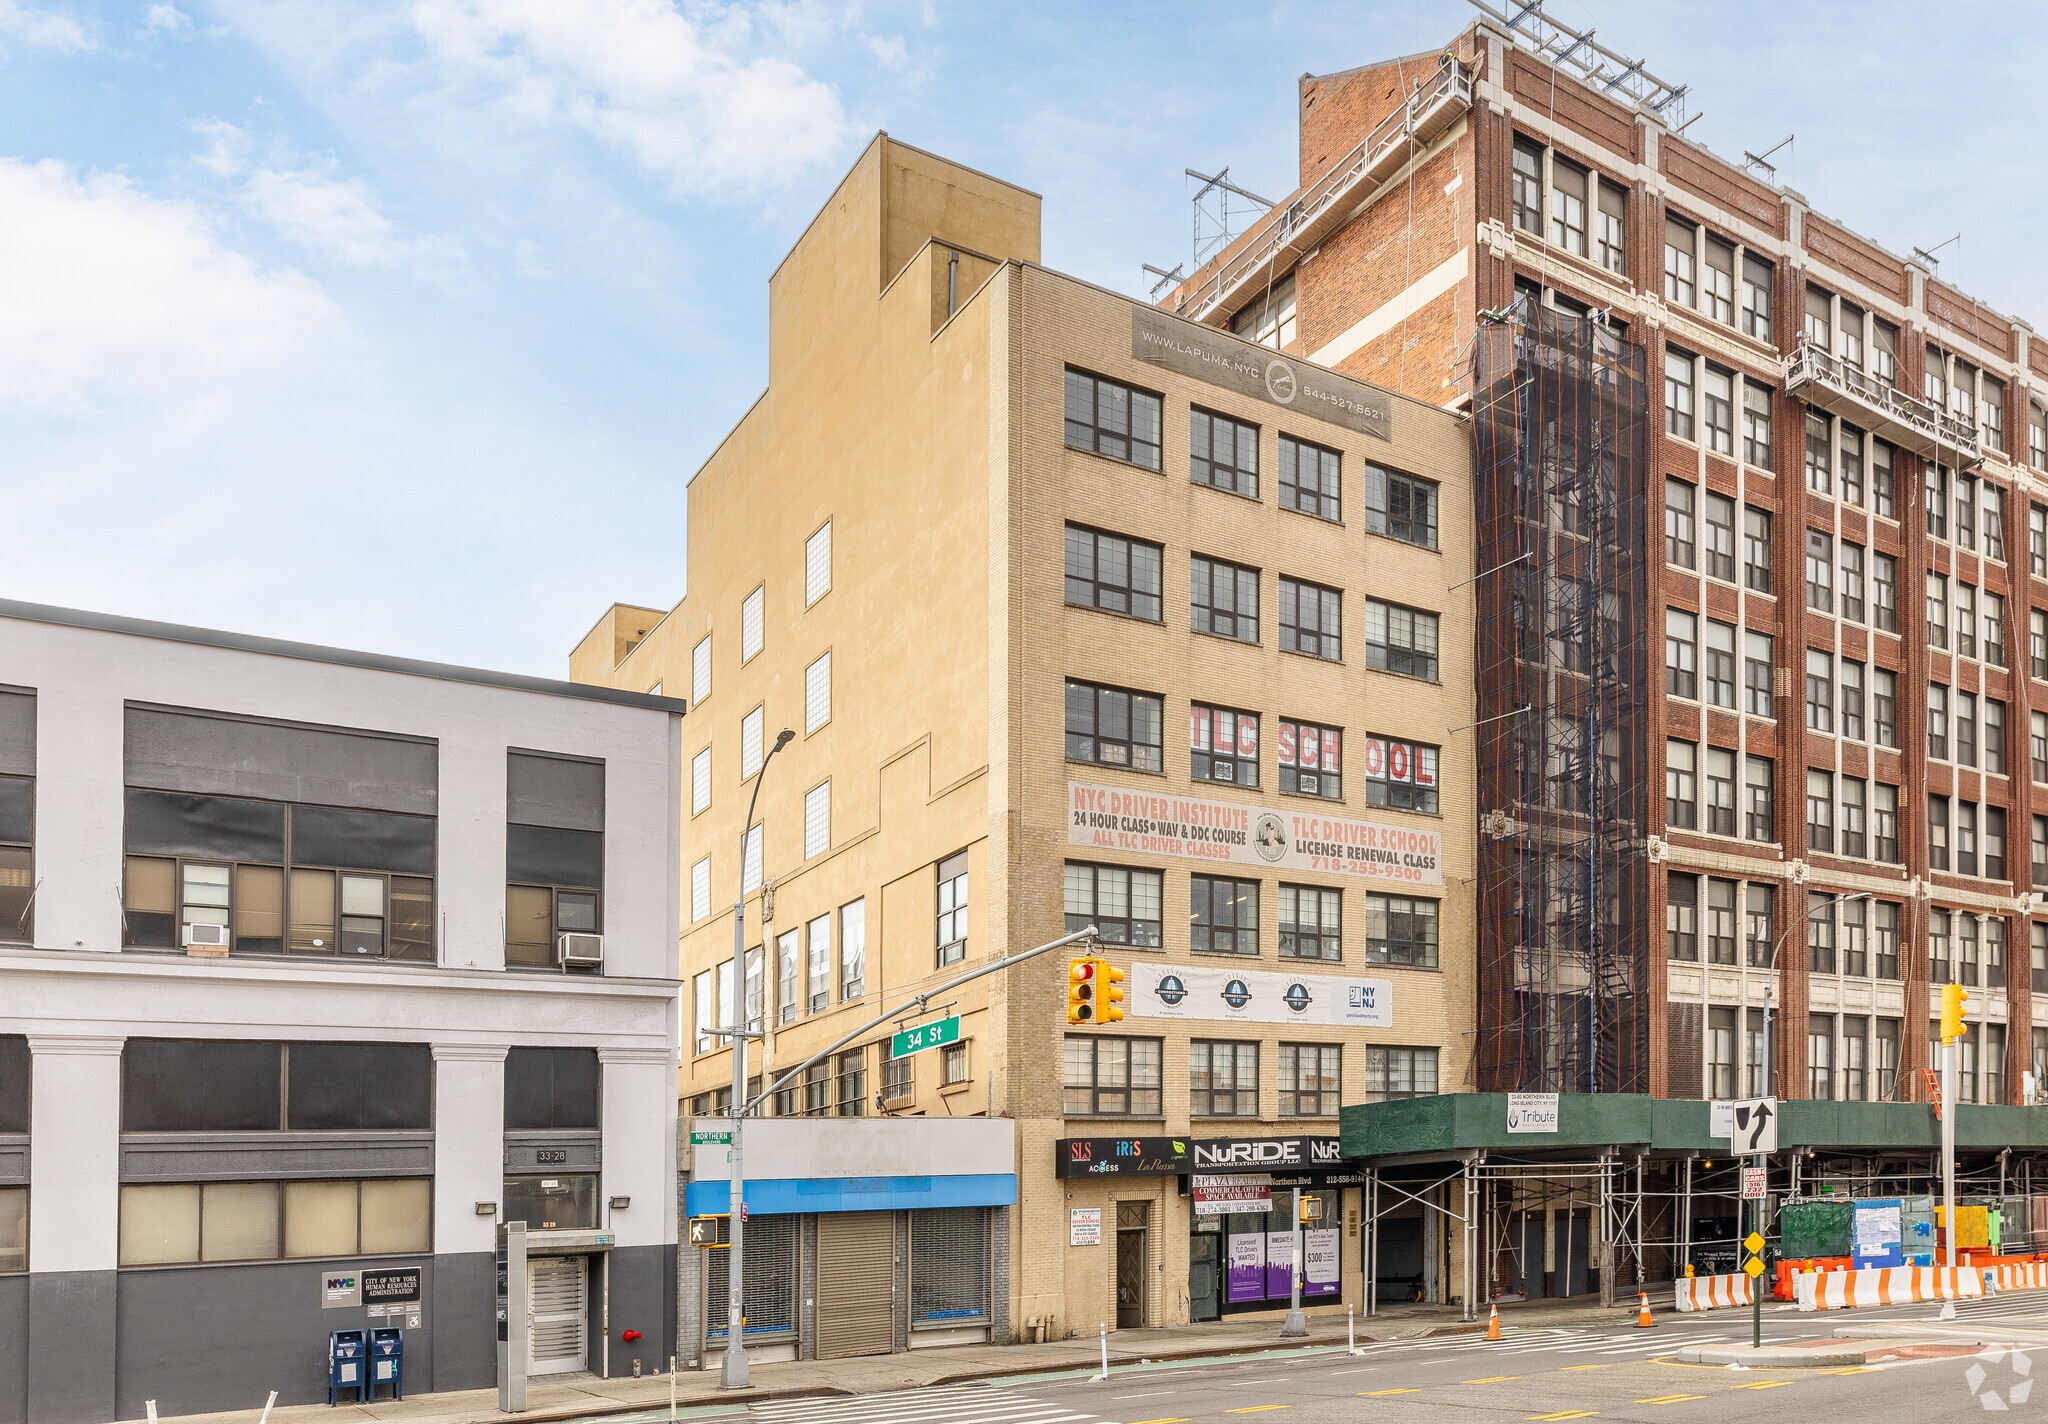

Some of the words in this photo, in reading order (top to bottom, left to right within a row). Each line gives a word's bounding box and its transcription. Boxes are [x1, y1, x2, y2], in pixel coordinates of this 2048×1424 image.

[1142, 330, 1259, 378] WWW.LAPUMA.NYC
[1303, 385, 1384, 420] 844-527-8621
[1191, 706, 1256, 755] TLC
[1074, 786, 1106, 813] NYC
[1111, 791, 1169, 820] DRIVER
[1173, 800, 1248, 831] INSTITUTE
[1074, 810, 1087, 826] 24
[1089, 812, 1118, 831] HOUR
[1121, 817, 1149, 834] CLASS
[1158, 821, 1178, 837] WAV
[1181, 824, 1188, 839] &
[1191, 825, 1209, 841] DDC
[1212, 828, 1246, 845] COURSE
[1293, 816, 1318, 839] TLC
[1323, 820, 1377, 847] DRIVER
[1381, 828, 1437, 855] SCHOOL
[1093, 829, 1114, 847] ALL
[1118, 832, 1137, 849] TLC
[1141, 835, 1182, 854] DRIVER
[1186, 840, 1231, 860] CLASSES
[1296, 839, 1343, 858] LICENSE
[1347, 845, 1400, 865] RENEWAL
[1404, 853, 1435, 869] CLASS
[1311, 856, 1422, 881] 718-255-9500
[1362, 986, 1375, 997] NY
[1362, 998, 1375, 1008] NJ
[907, 1030, 923, 1049] 34
[929, 1025, 943, 1042] St
[1522, 1109, 1555, 1122] Tribute
[695, 1132, 728, 1140] NORTHERN
[540, 1151, 565, 1160] 33-28
[1071, 1141, 1092, 1159] SLS
[1137, 1158, 1149, 1171] La
[1195, 1160, 1260, 1168] TRANSPORTATION
[1202, 1176, 1230, 1186] PLAZA
[1271, 1177, 1298, 1186] Northern
[1298, 1176, 1311, 1185] Blvd
[1205, 1193, 1226, 1201] SPACE
[1227, 1192, 1260, 1200] AVAILABLE
[1238, 1253, 1255, 1261] WANTED
[1307, 1252, 1322, 1263] $300
[328, 1278, 355, 1288] NYC
[369, 1288, 414, 1296] ADMINISTRATION
